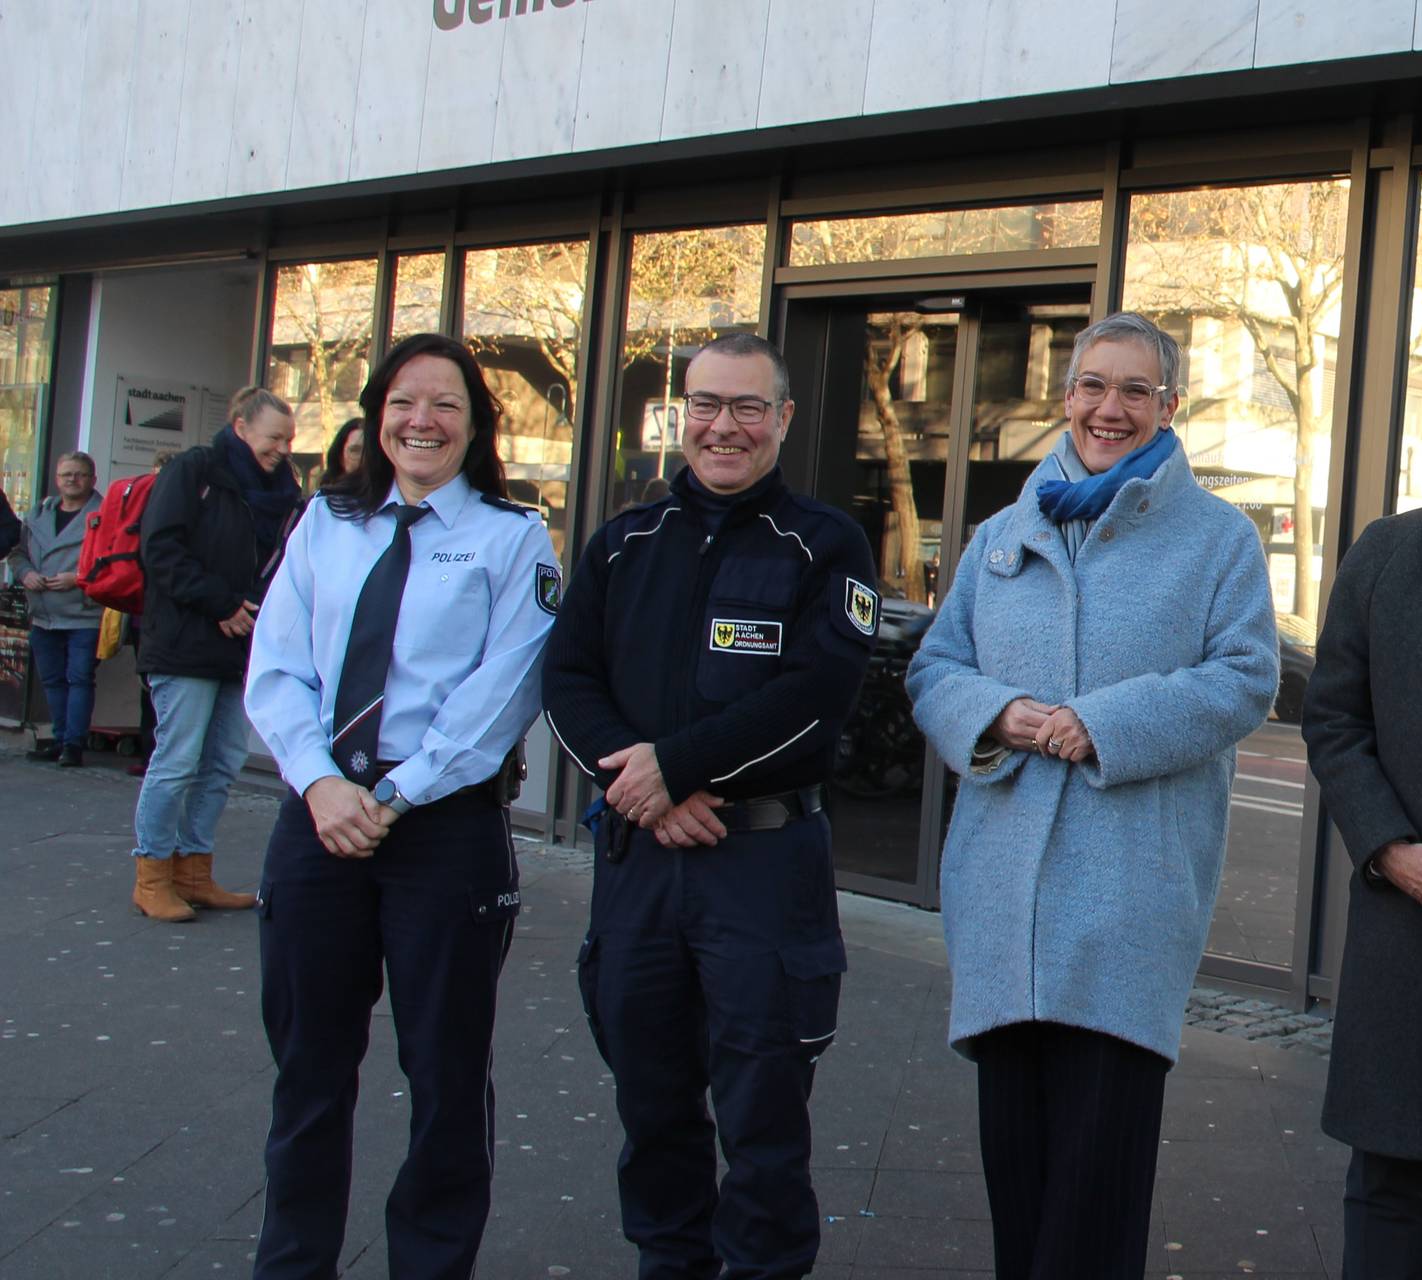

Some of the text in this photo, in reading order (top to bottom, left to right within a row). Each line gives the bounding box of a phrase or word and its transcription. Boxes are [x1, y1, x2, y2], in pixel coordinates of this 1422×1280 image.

[432, 552, 476, 563] POLIZEI
[735, 624, 757, 632] STADT
[735, 631, 764, 640] AACHEN
[734, 641, 778, 650] ORDNUNGSAMT
